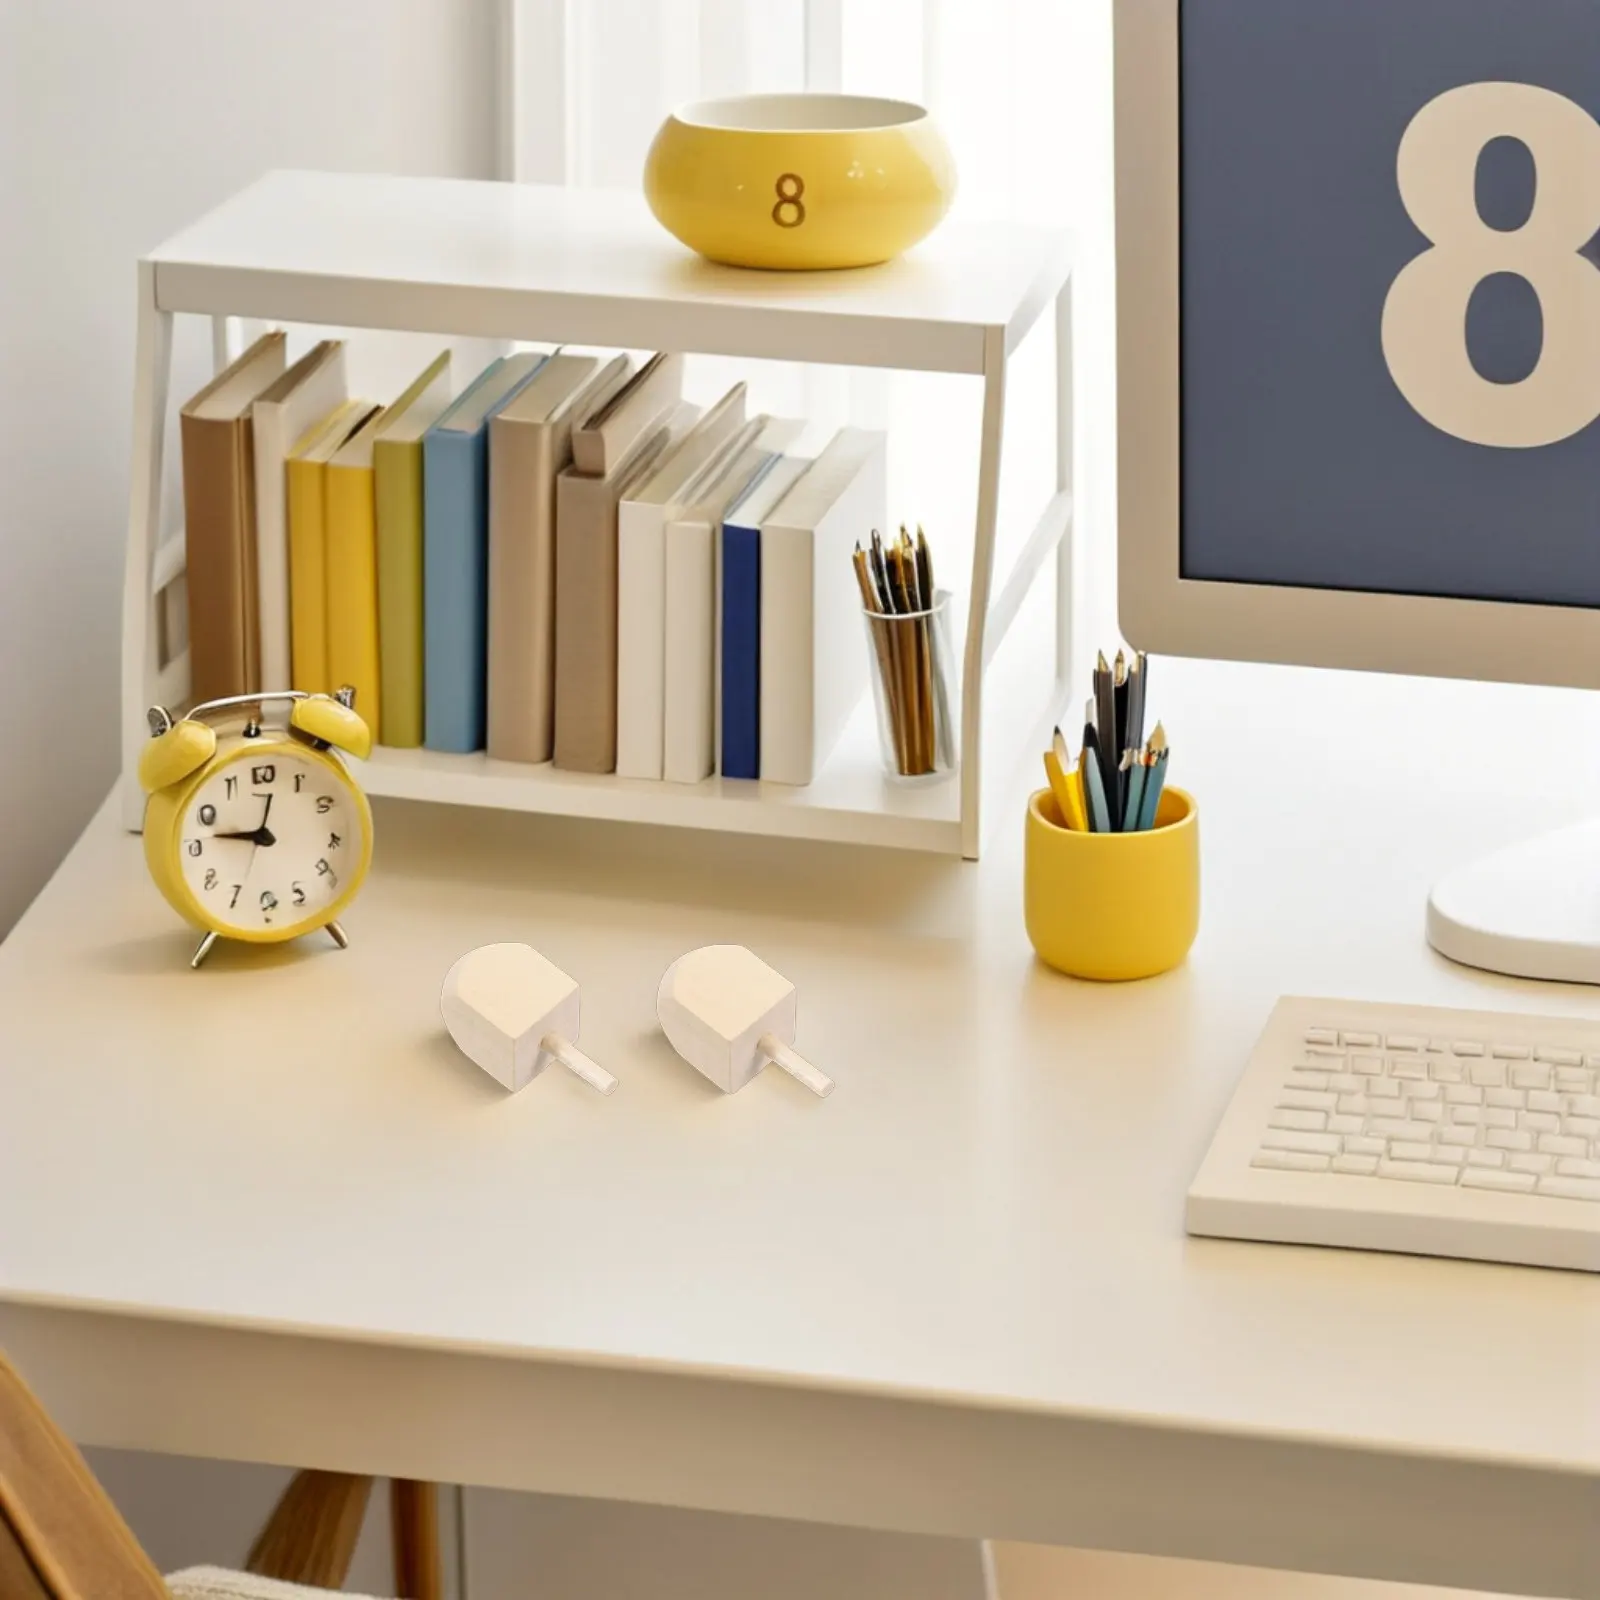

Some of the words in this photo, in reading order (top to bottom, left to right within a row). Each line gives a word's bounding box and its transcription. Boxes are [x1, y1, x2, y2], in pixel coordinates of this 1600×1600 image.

[772, 173, 805, 228] 8
[1381, 81, 1600, 448] 8
[230, 884, 242, 909] 7
